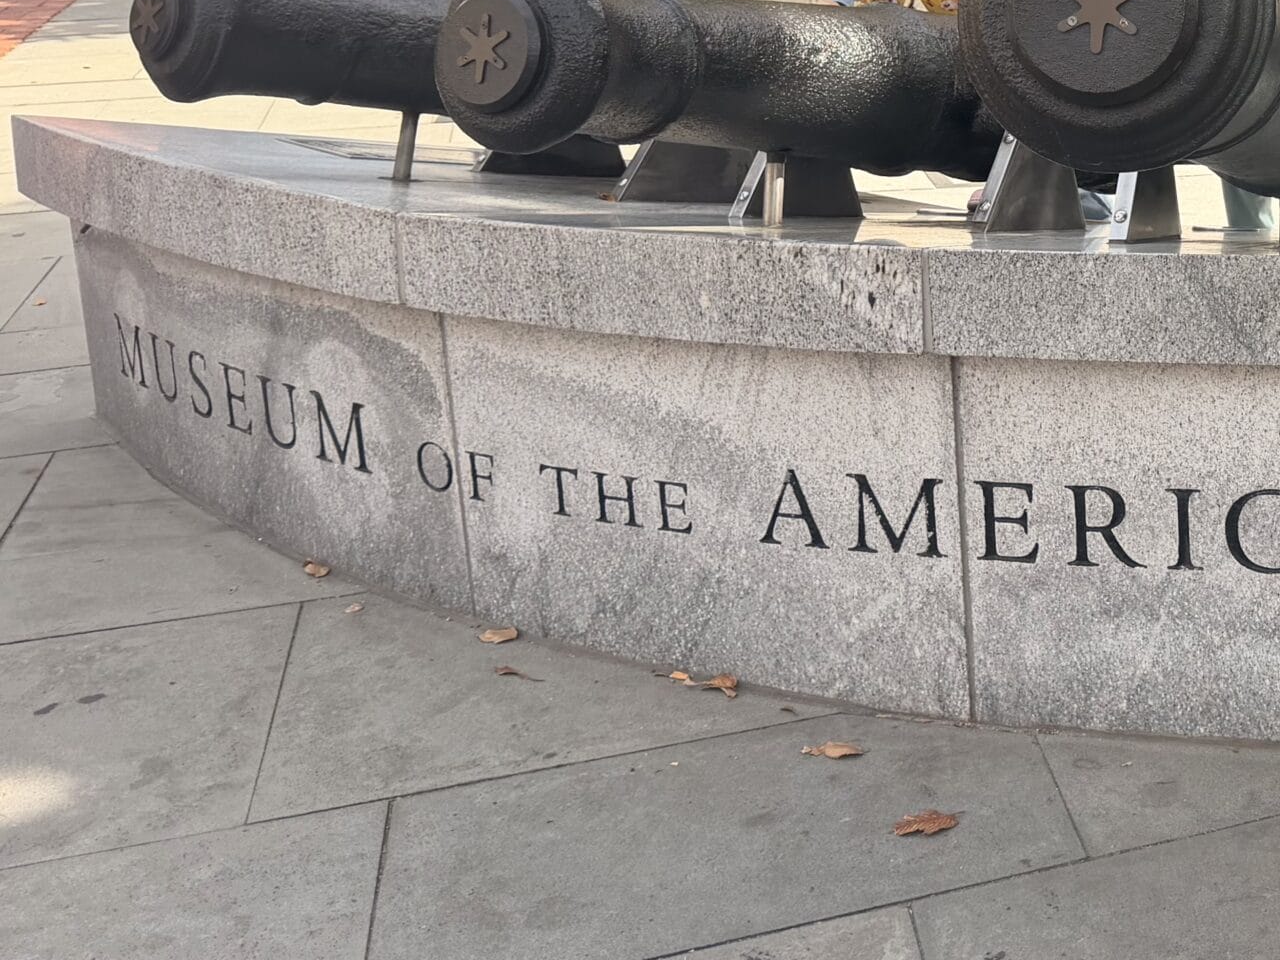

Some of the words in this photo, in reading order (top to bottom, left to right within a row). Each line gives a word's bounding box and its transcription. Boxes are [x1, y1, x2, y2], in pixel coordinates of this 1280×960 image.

[113, 312, 373, 474] MUSEUM
[416, 441, 494, 502] OF
[539, 464, 692, 535] THE
